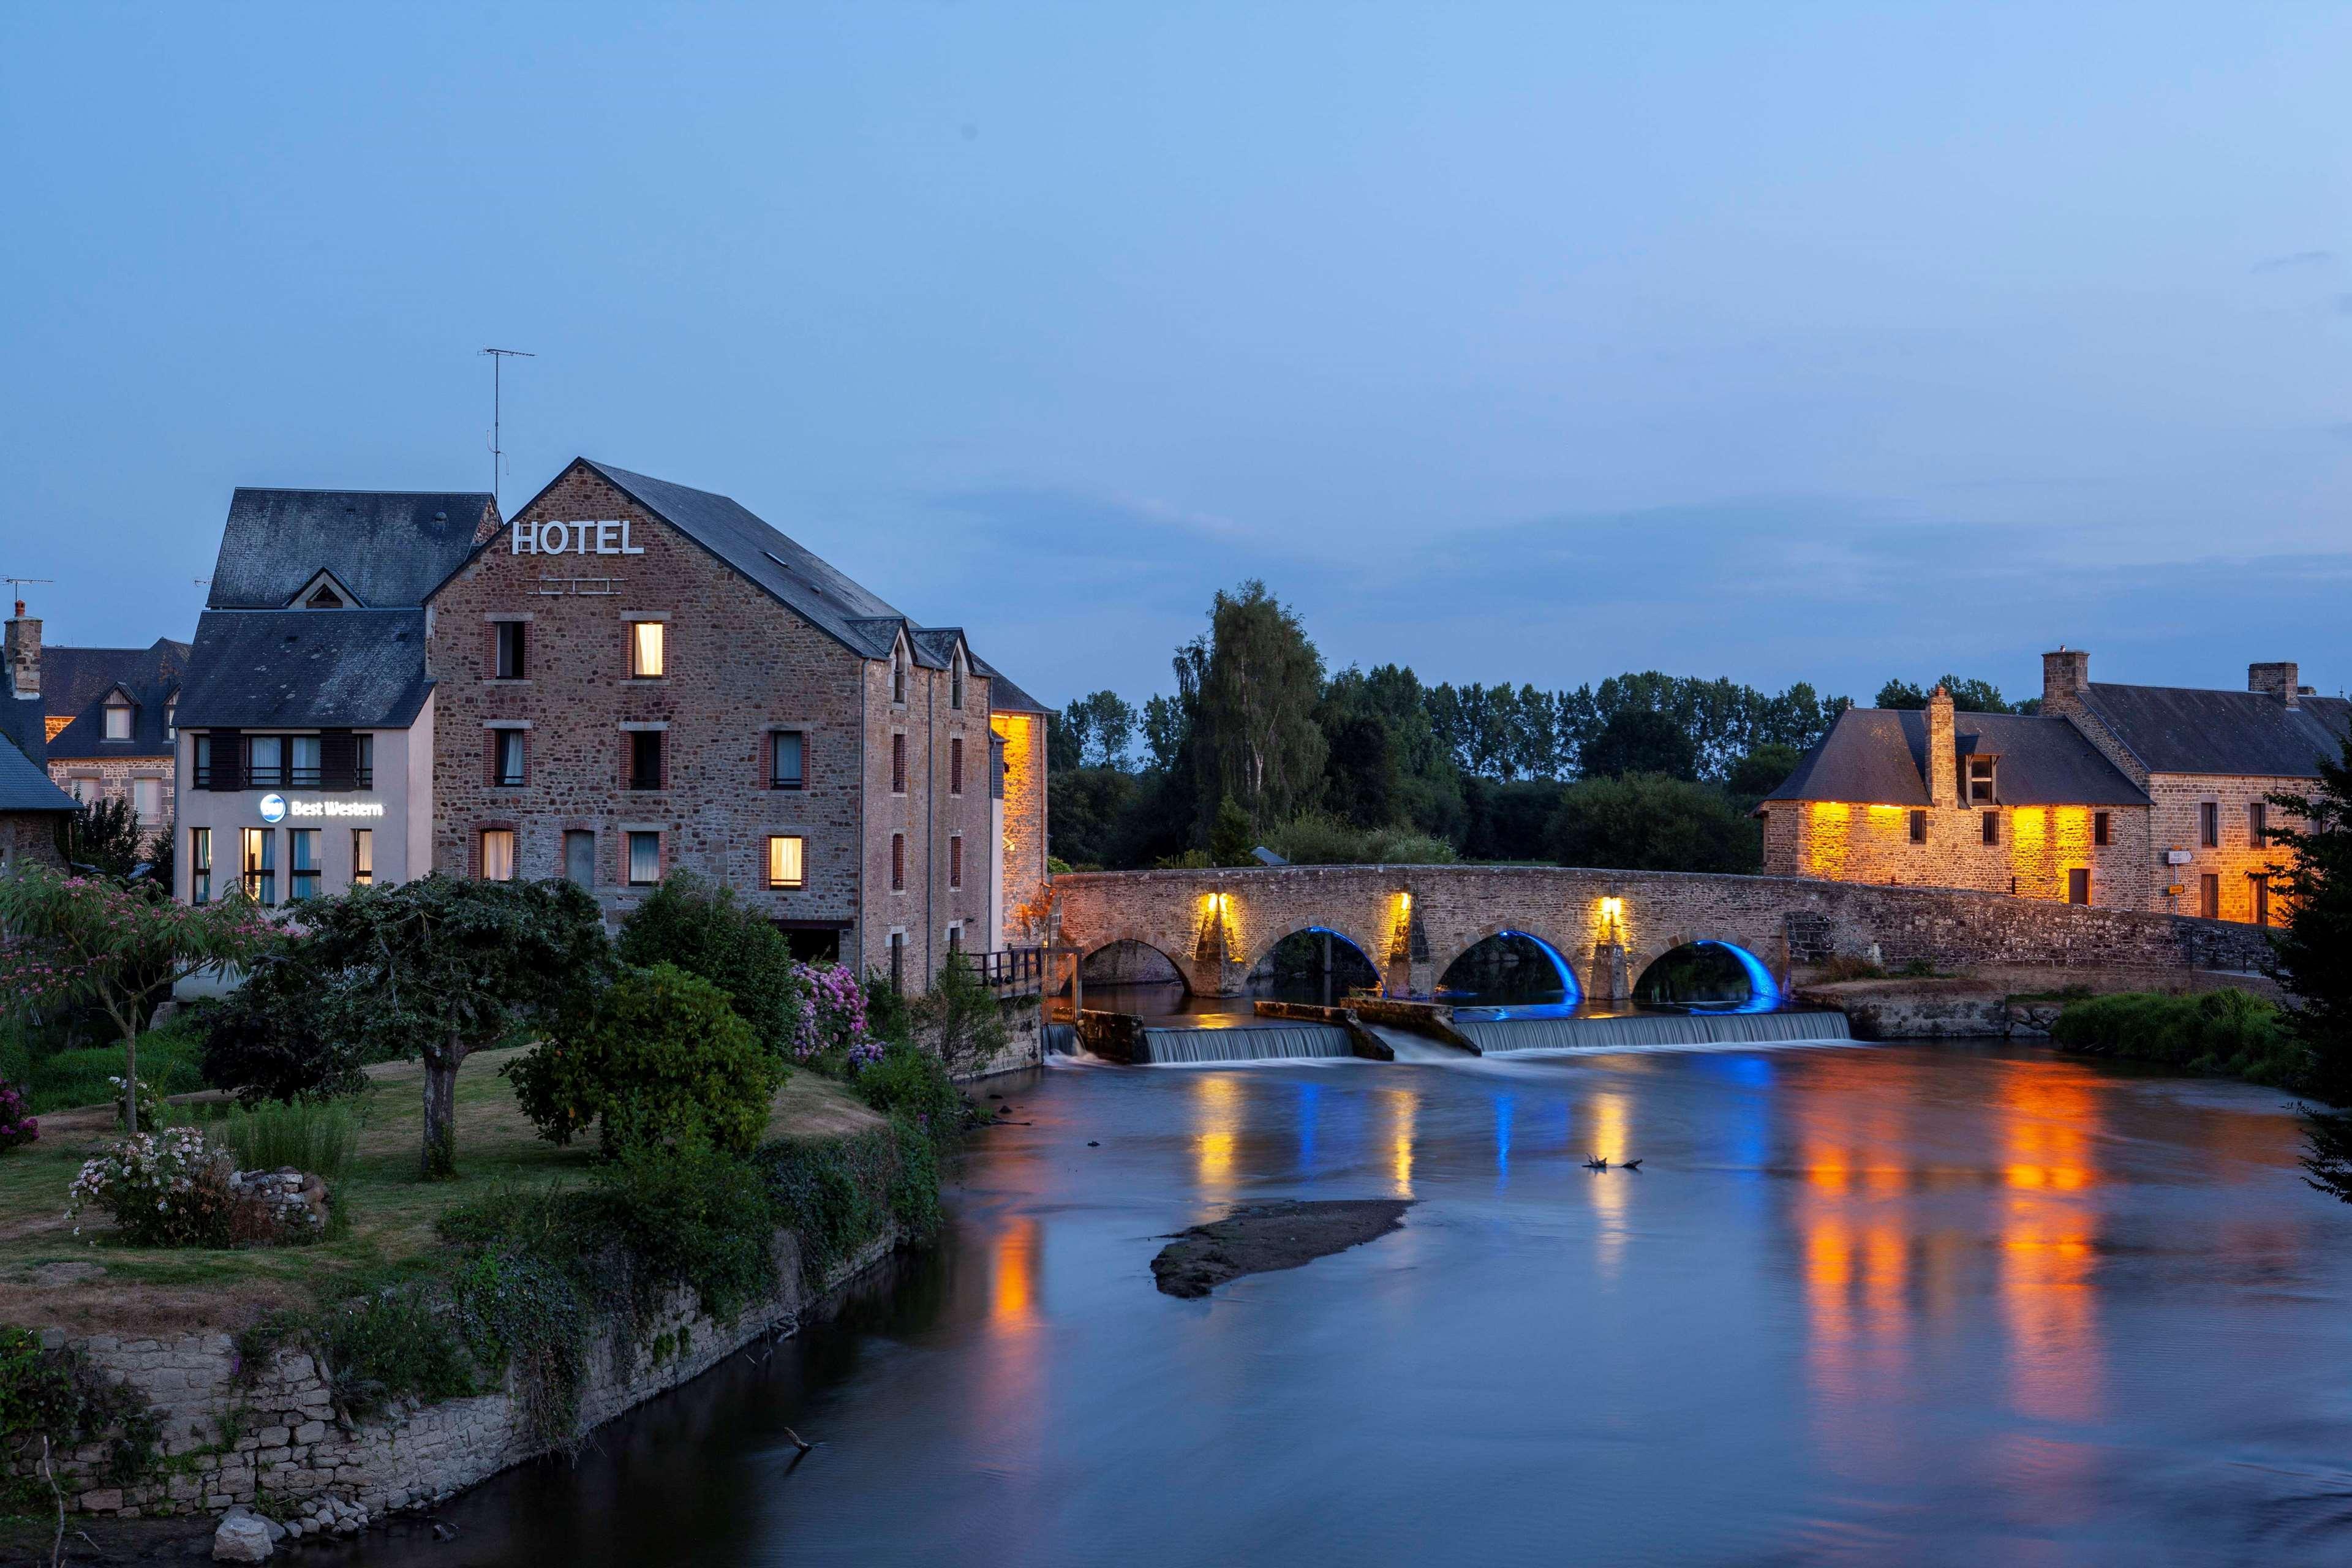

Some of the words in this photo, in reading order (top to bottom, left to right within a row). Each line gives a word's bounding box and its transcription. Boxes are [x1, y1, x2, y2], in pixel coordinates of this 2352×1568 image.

[512, 520, 644, 554] HOTEL
[291, 801, 323, 816] Best
[324, 801, 383, 816] Western
